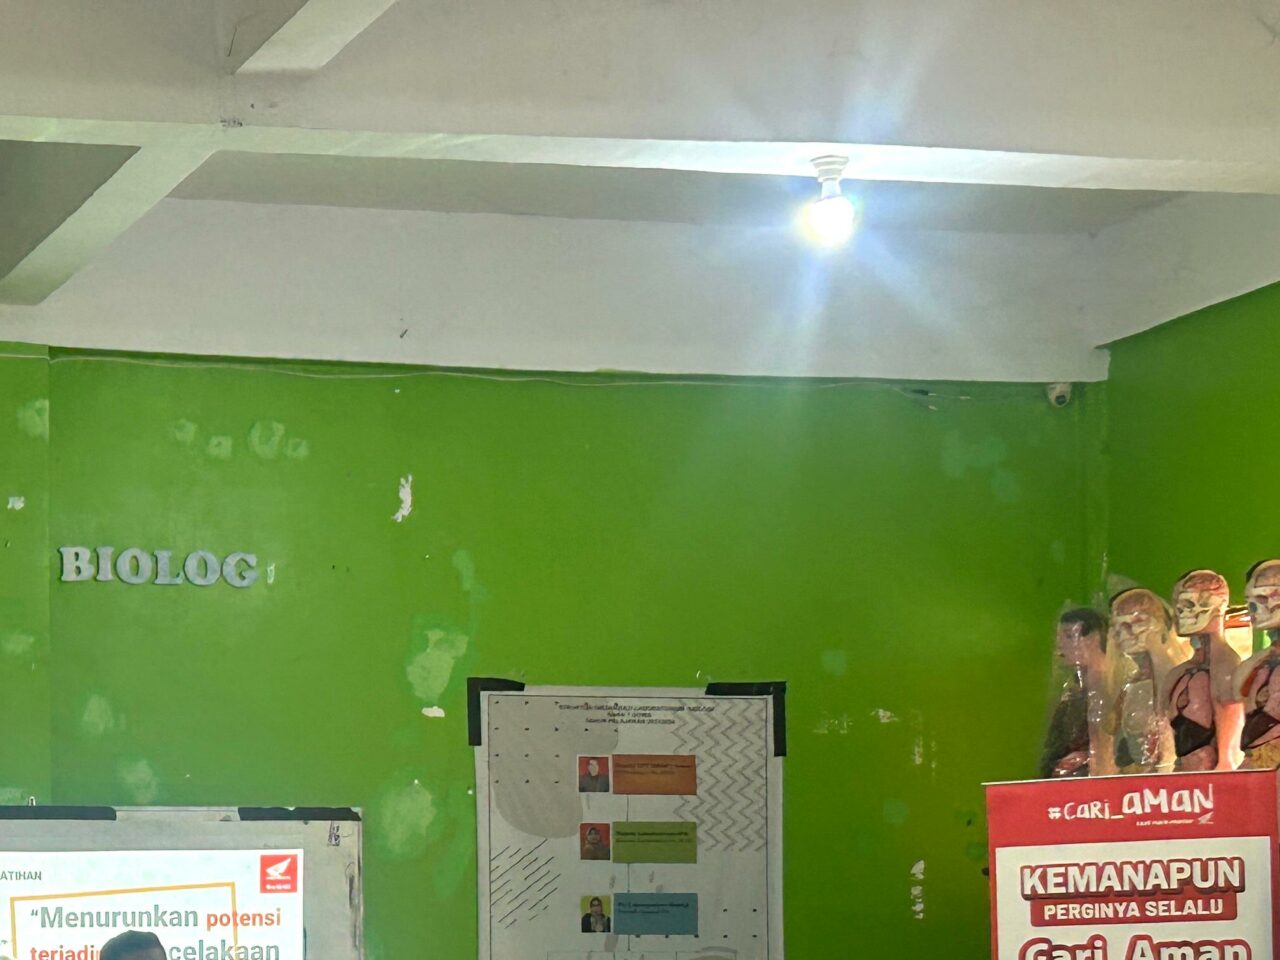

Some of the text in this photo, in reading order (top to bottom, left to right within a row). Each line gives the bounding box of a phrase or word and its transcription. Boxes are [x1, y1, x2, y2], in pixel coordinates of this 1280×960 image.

[59, 546, 258, 588] BIOLOG
[1022, 859, 1241, 895] KEMANAPUN
[206, 907, 282, 932] potensi
[1043, 898, 1224, 921] PERGINYA SELALU
